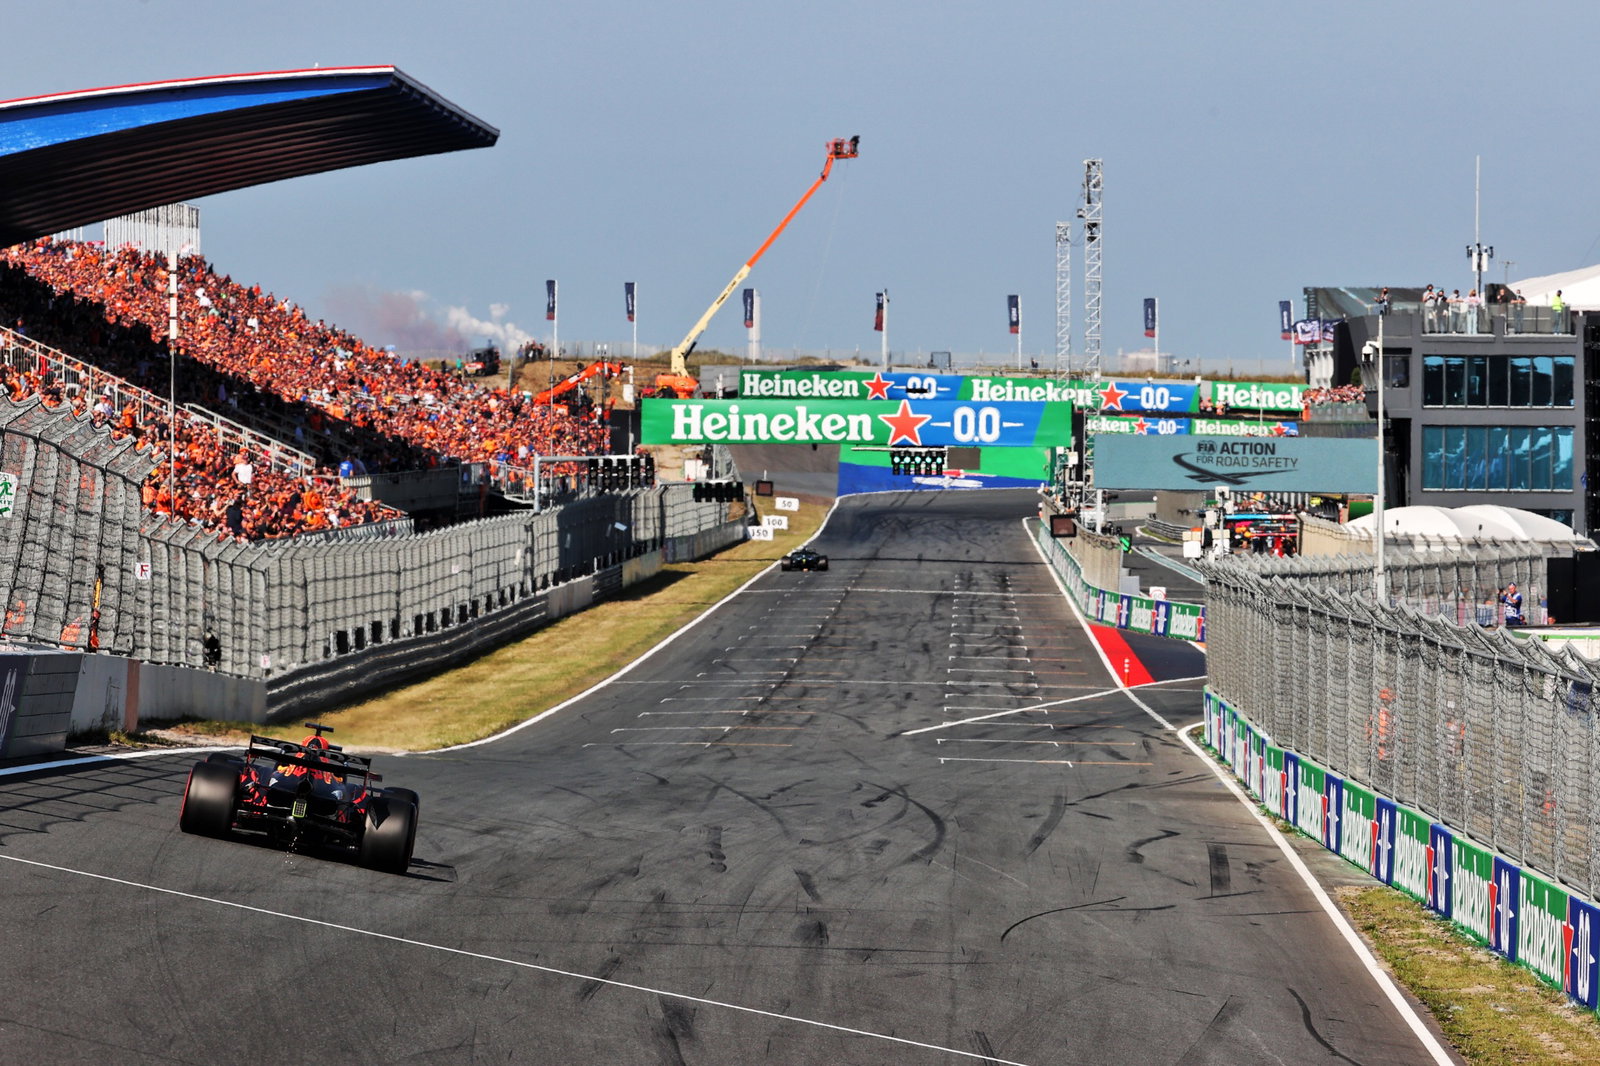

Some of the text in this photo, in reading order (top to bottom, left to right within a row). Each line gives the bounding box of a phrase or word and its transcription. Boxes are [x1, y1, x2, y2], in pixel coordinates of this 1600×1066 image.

[742, 373, 937, 399] Heineken 0.0
[971, 378, 1170, 409] Heineken 0.0
[1216, 383, 1304, 409] Heinek
[671, 404, 1000, 442] Heineken 0.0
[1194, 420, 1269, 436] Heineken
[1197, 442, 1276, 455] FIA ACTION
[1196, 455, 1298, 468] FOR ROAD SAFETY
[782, 500, 792, 508] 50
[767, 518, 783, 527] 100
[751, 528, 768, 537] 150
[140, 564, 149, 577] F
[1452, 843, 1489, 940] Heineken
[1518, 875, 1561, 985] Heineken
